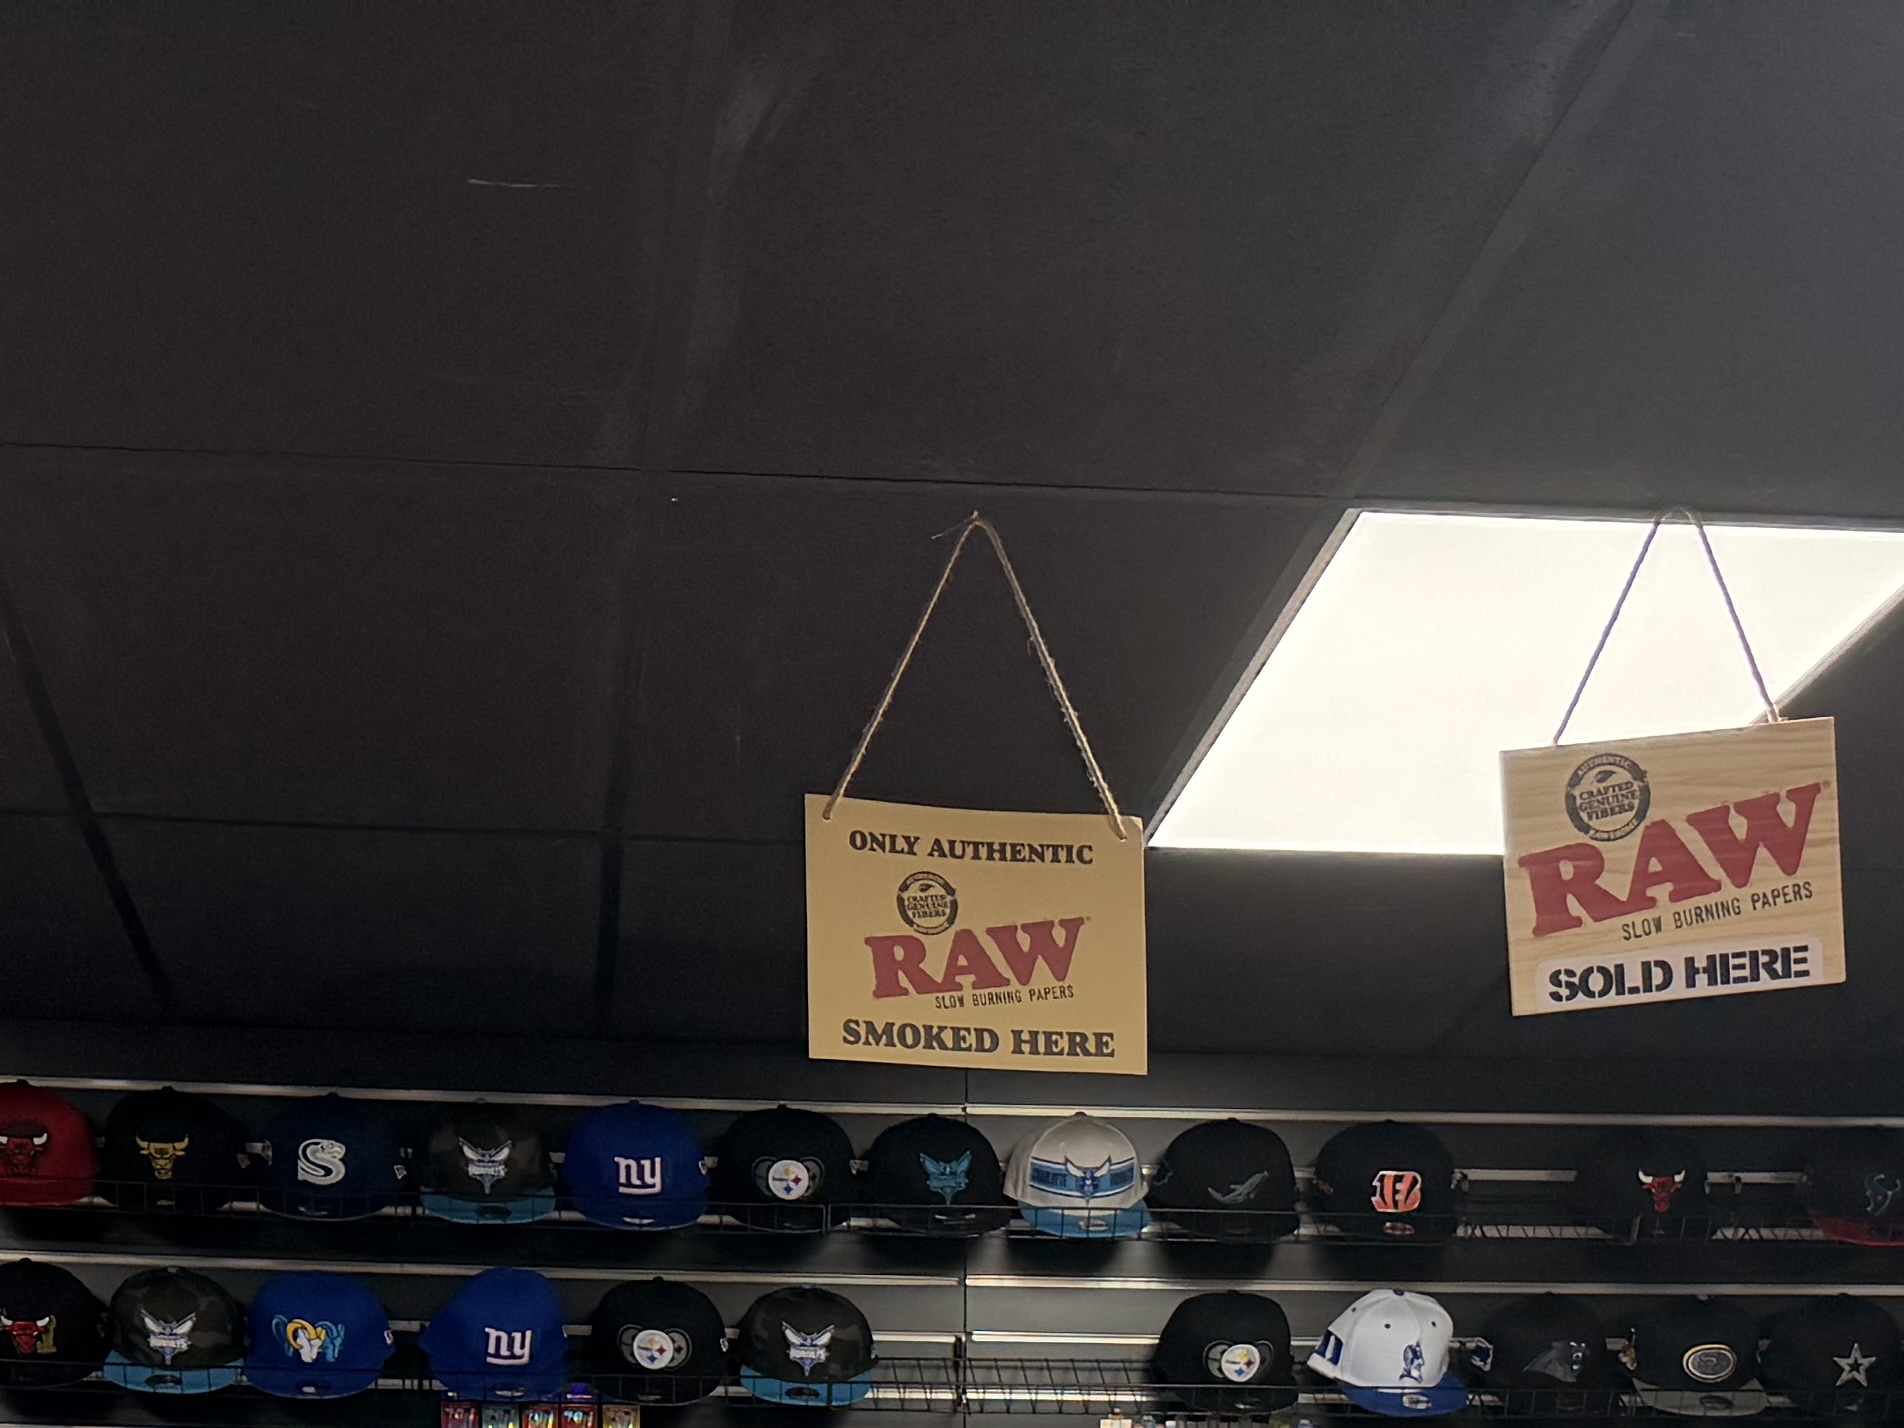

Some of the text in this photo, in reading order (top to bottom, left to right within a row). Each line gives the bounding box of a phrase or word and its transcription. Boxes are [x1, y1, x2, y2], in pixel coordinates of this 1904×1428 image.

[1578, 780, 1635, 801] CRAFTED
[1578, 789, 1639, 812] GENUINE
[1587, 801, 1635, 822] FIBERS
[849, 829, 1094, 865] ONLY AUTHENTIC
[1518, 782, 1822, 938] RAW
[1621, 881, 1814, 941] SLOW BURNING PAPERS
[864, 917, 1085, 1000] RAW
[1548, 945, 1810, 1003] SOLD HERE
[935, 984, 1074, 1009] SLOW BURNING PAPERS
[842, 1018, 1116, 1059] SMOKED HERE
